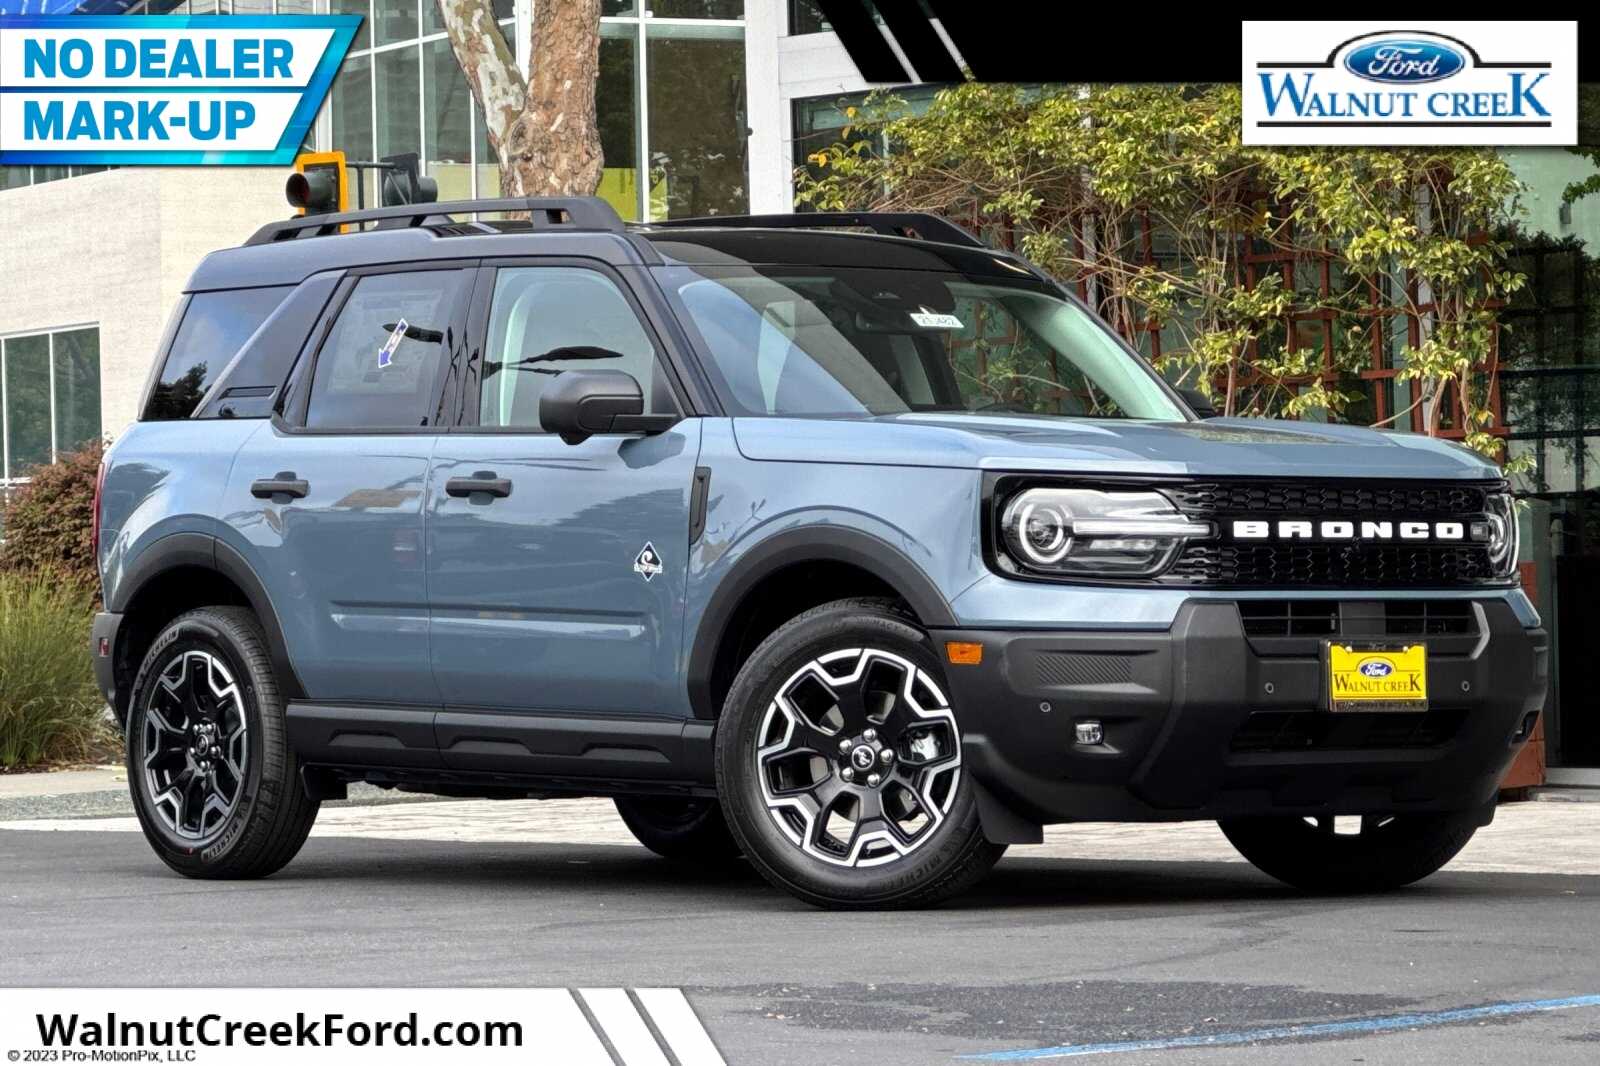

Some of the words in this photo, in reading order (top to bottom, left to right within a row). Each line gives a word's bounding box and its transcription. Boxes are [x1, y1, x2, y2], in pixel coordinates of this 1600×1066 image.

[1233, 520, 1464, 538] BRONCO
[1364, 662, 1388, 677] Ford
[1334, 673, 1383, 692] WALNUT
[1384, 673, 1421, 692] CREEK
